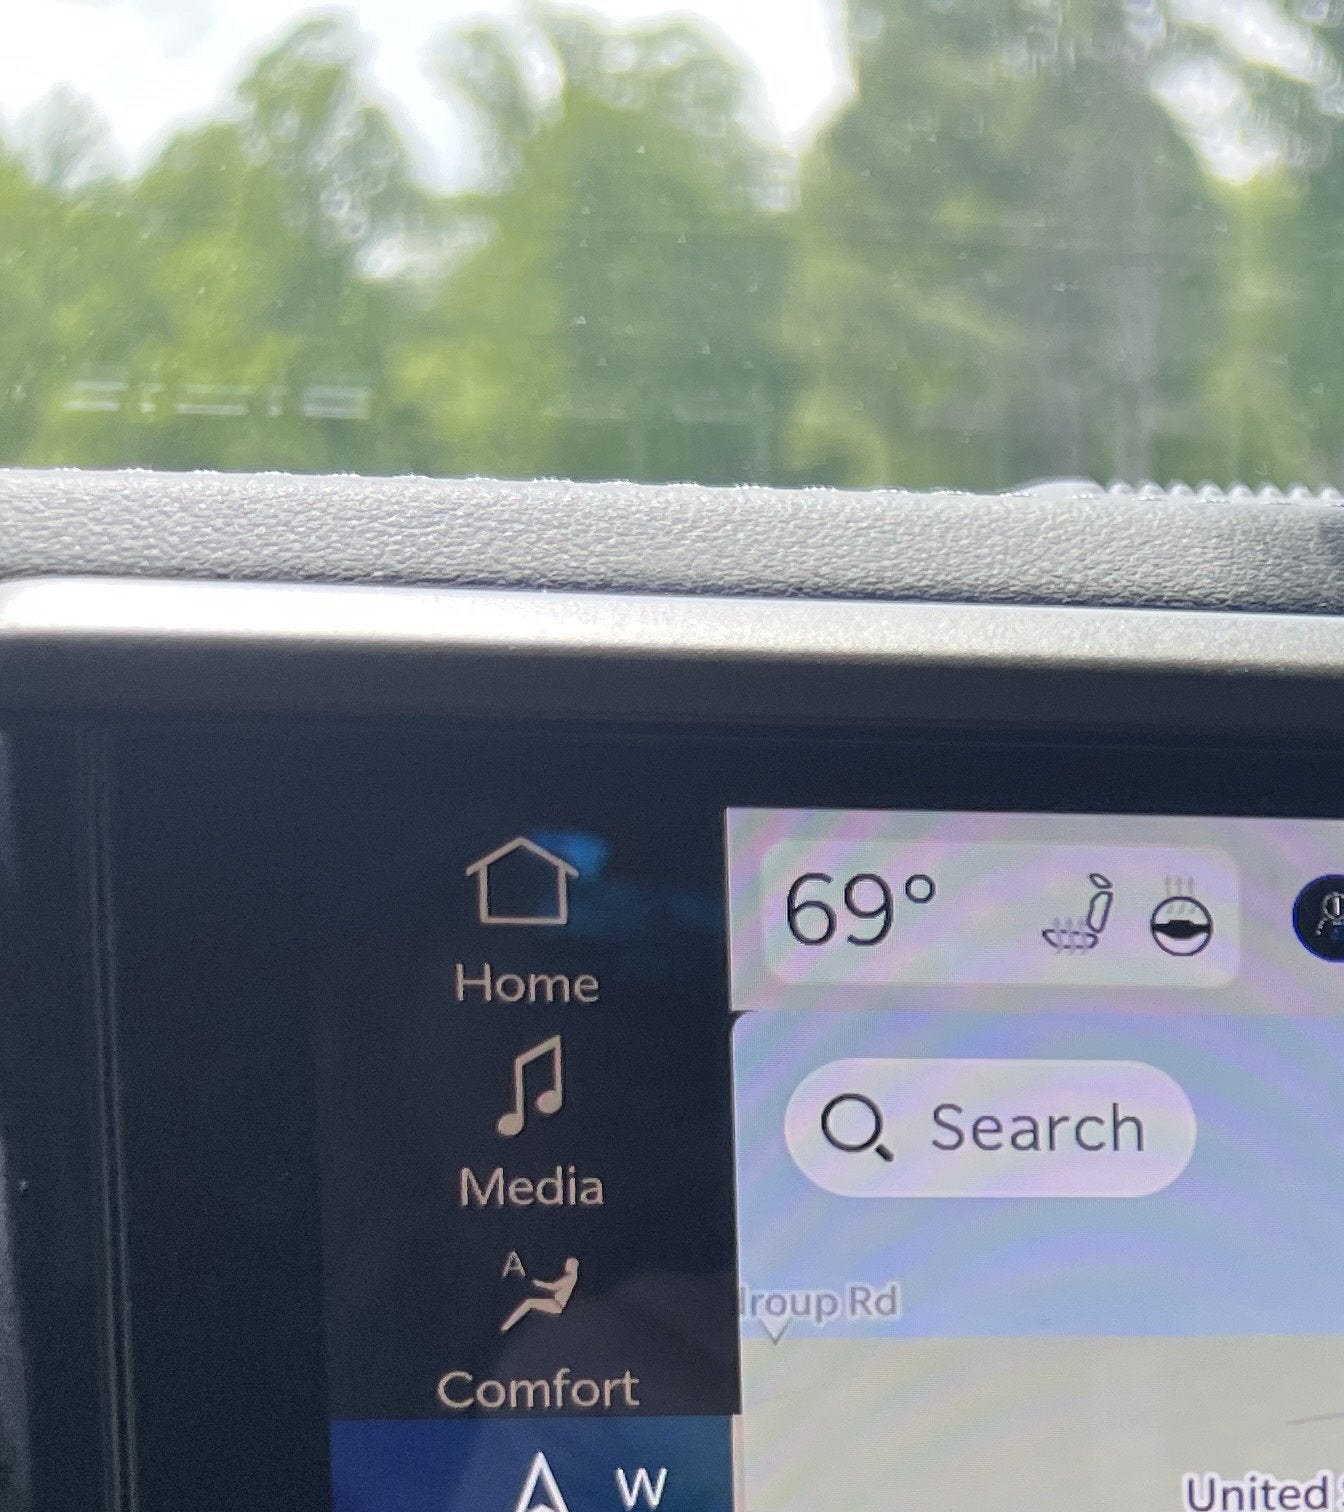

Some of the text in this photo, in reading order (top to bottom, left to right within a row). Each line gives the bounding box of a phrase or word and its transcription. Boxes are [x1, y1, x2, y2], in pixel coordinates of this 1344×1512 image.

[455, 963, 600, 1005] Home
[930, 1102, 1146, 1154] Search
[458, 1166, 605, 1207] Media
[501, 1250, 526, 1278] A
[850, 1285, 897, 1316] Rd
[436, 1369, 641, 1409] Comfort
[616, 1467, 668, 1512] W
[1186, 1474, 1330, 1512] United
